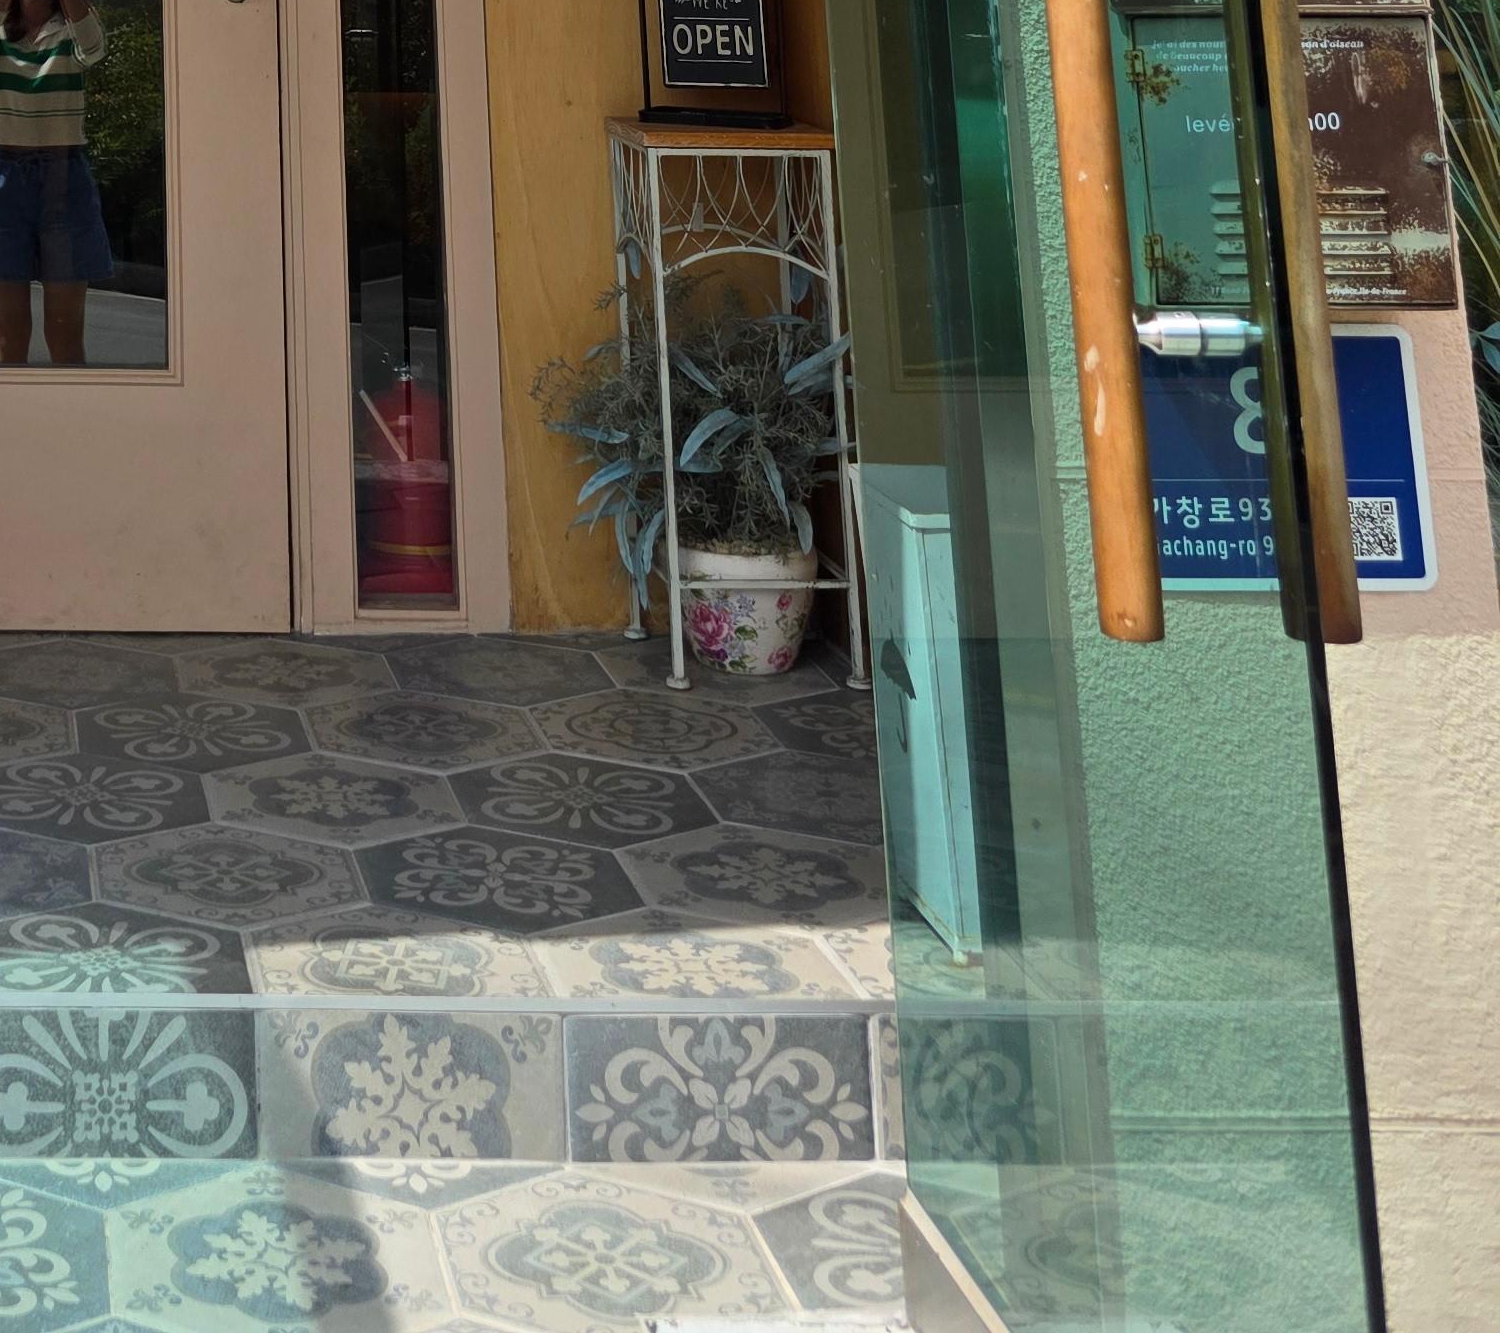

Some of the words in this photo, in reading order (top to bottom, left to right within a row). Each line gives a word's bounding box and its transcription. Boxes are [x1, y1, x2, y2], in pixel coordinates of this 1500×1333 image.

[672, 23, 755, 56] OPEN
[1185, 113, 1235, 133] levé
[1153, 495, 1274, 529] 가창로93
[1157, 535, 1257, 561] achang-ro
[1263, 535, 1275, 556] 9
